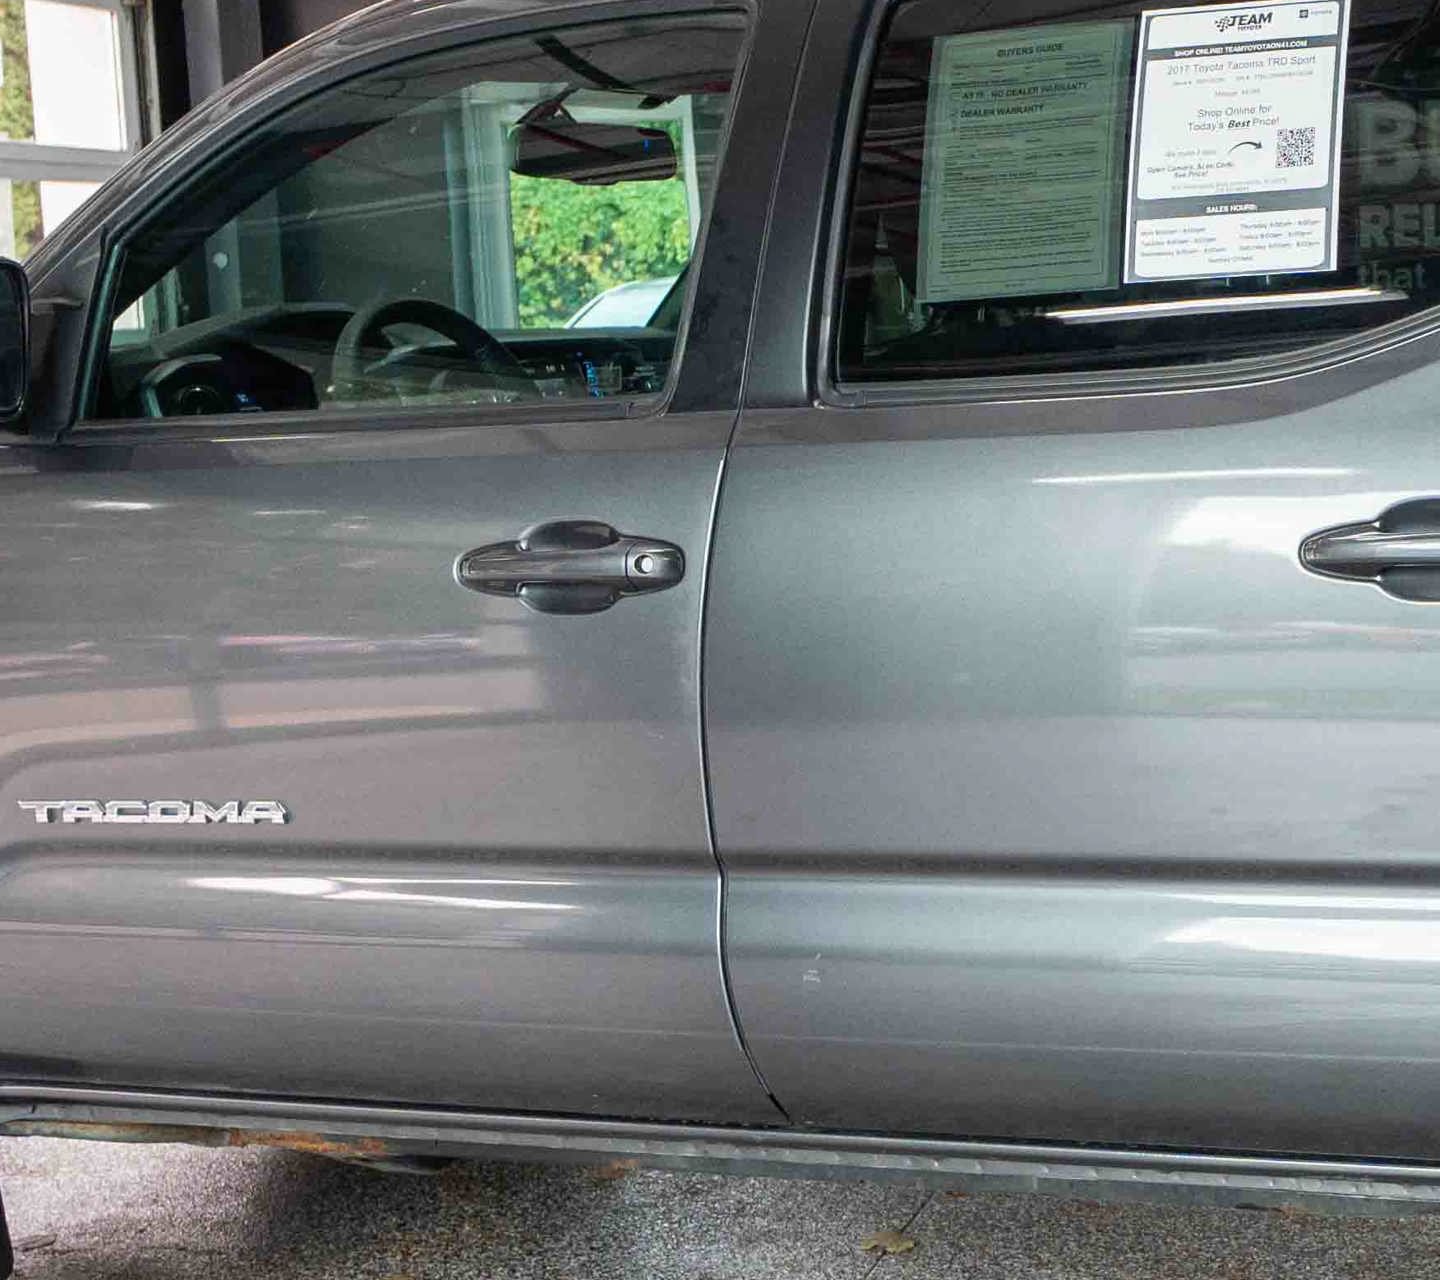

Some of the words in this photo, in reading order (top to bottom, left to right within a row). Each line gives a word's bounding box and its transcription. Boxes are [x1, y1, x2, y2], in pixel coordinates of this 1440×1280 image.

[1229, 11, 1273, 27] TEAM
[996, 46, 1035, 58] BUYERS
[1036, 42, 1065, 53] GUIDE
[1173, 48, 1194, 58] SHOP
[1167, 64, 1191, 76] 2017
[1192, 62, 1225, 75] Toyota
[1227, 59, 1265, 70] Tacoma
[1267, 56, 1288, 67] TRD
[1289, 55, 1317, 67] Sport
[991, 89, 1005, 99] NO
[1006, 86, 1040, 98] DEALER
[1042, 81, 1090, 94] WARRANTY
[960, 108, 995, 119] DEALER
[997, 104, 1045, 116] WARRANTY
[1197, 108, 1223, 121] Shop
[1224, 105, 1257, 117] Online
[1257, 104, 1272, 114] for
[1187, 118, 1225, 132] Today's
[1227, 119, 1251, 130] Best
[1252, 116, 1280, 128] Price!
[1205, 204, 1230, 215] SALES
[1360, 261, 1428, 291] that
[16, 798, 292, 826] TACOMA
